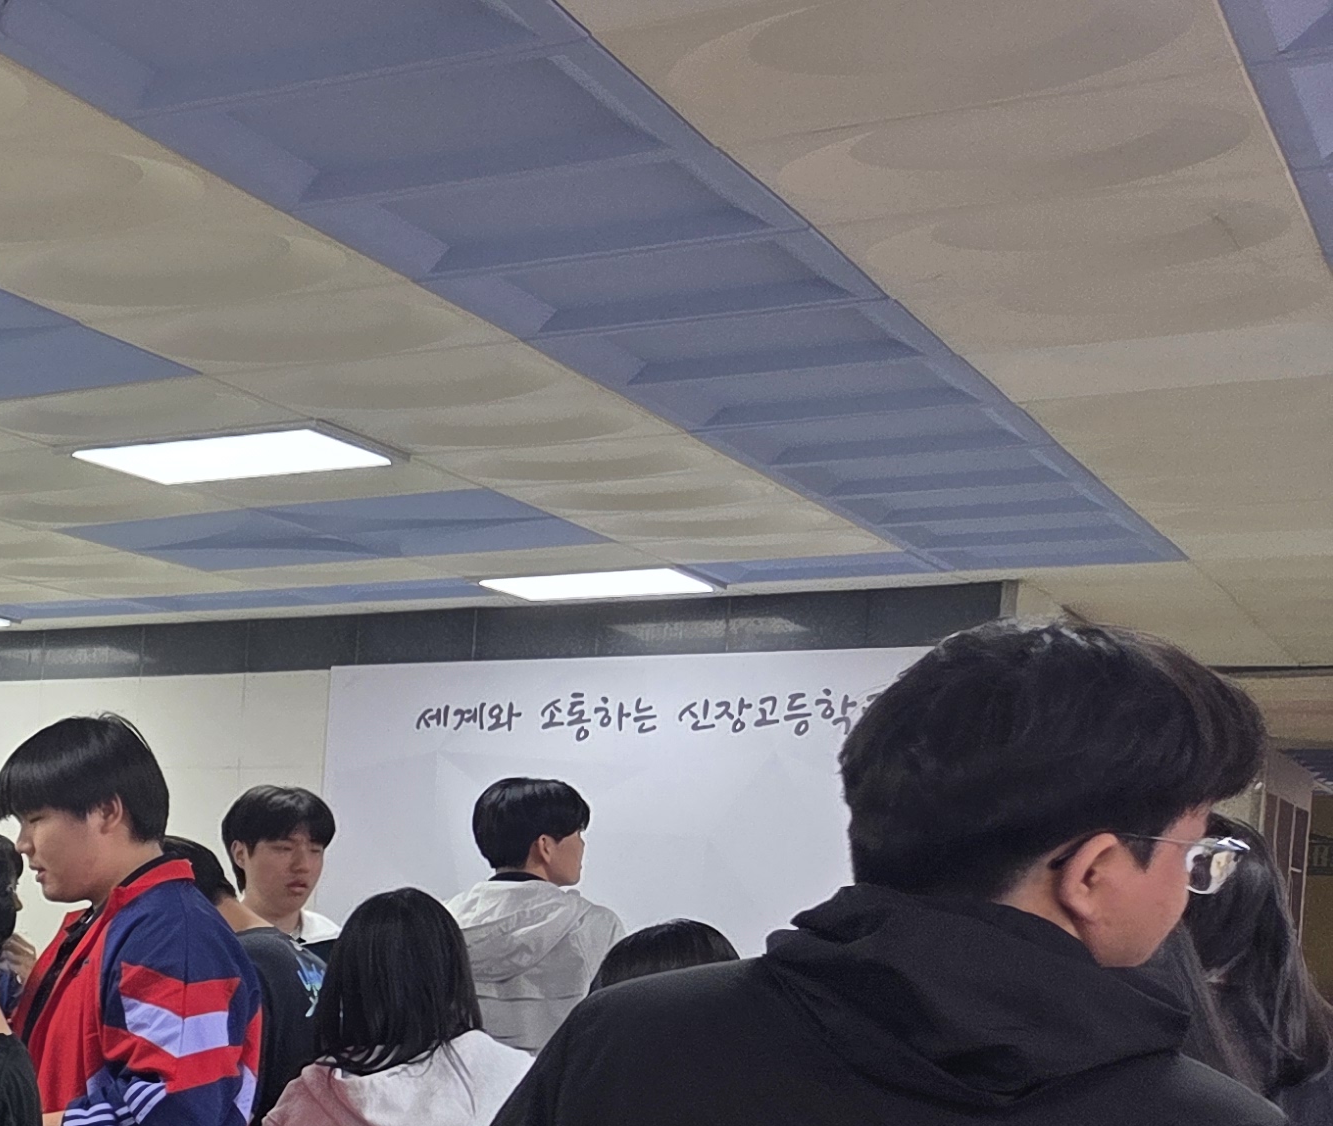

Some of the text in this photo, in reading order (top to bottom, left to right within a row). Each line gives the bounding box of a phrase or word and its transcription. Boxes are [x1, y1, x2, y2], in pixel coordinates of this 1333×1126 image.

[415, 687, 881, 742] 세계와 소통하는 신장고등학
